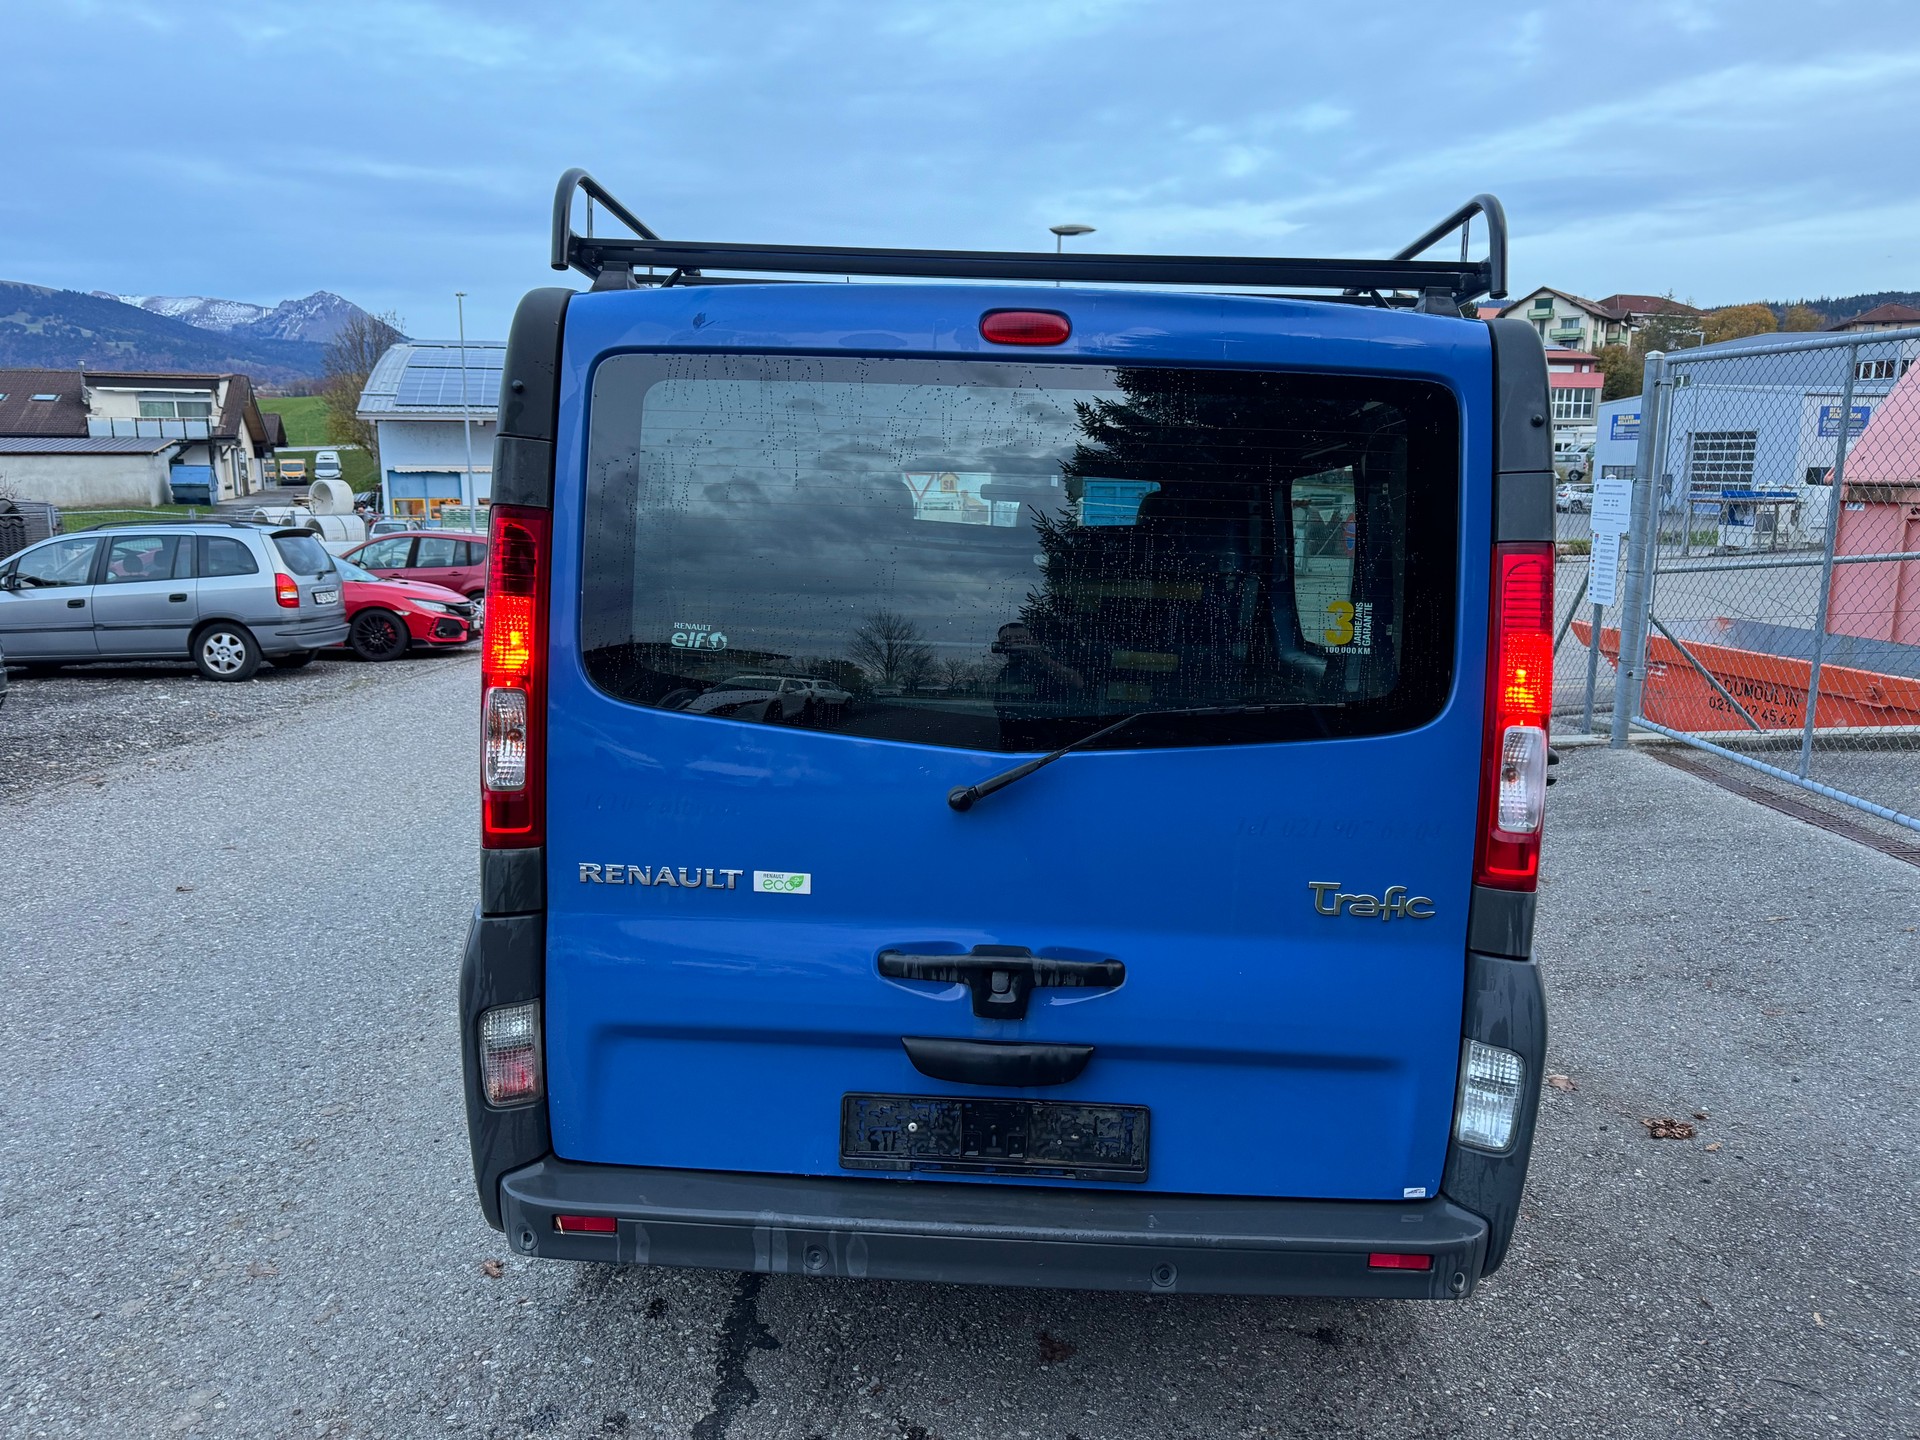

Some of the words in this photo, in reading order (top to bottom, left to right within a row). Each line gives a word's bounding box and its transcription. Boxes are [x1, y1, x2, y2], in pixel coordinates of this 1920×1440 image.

[943, 480, 954, 490] SA
[674, 622, 712, 631] RENAULT
[1325, 600, 1354, 645] 3
[1354, 602, 1364, 646] JAHRE/ANS
[1362, 602, 1373, 646] GARANTIE
[671, 632, 707, 648] elf
[1357, 647, 1371, 655] KM
[1709, 696, 1731, 712] 021
[1761, 708, 1778, 722] 45
[578, 862, 744, 890] RENAULT
[1308, 881, 1436, 921] Trafic
